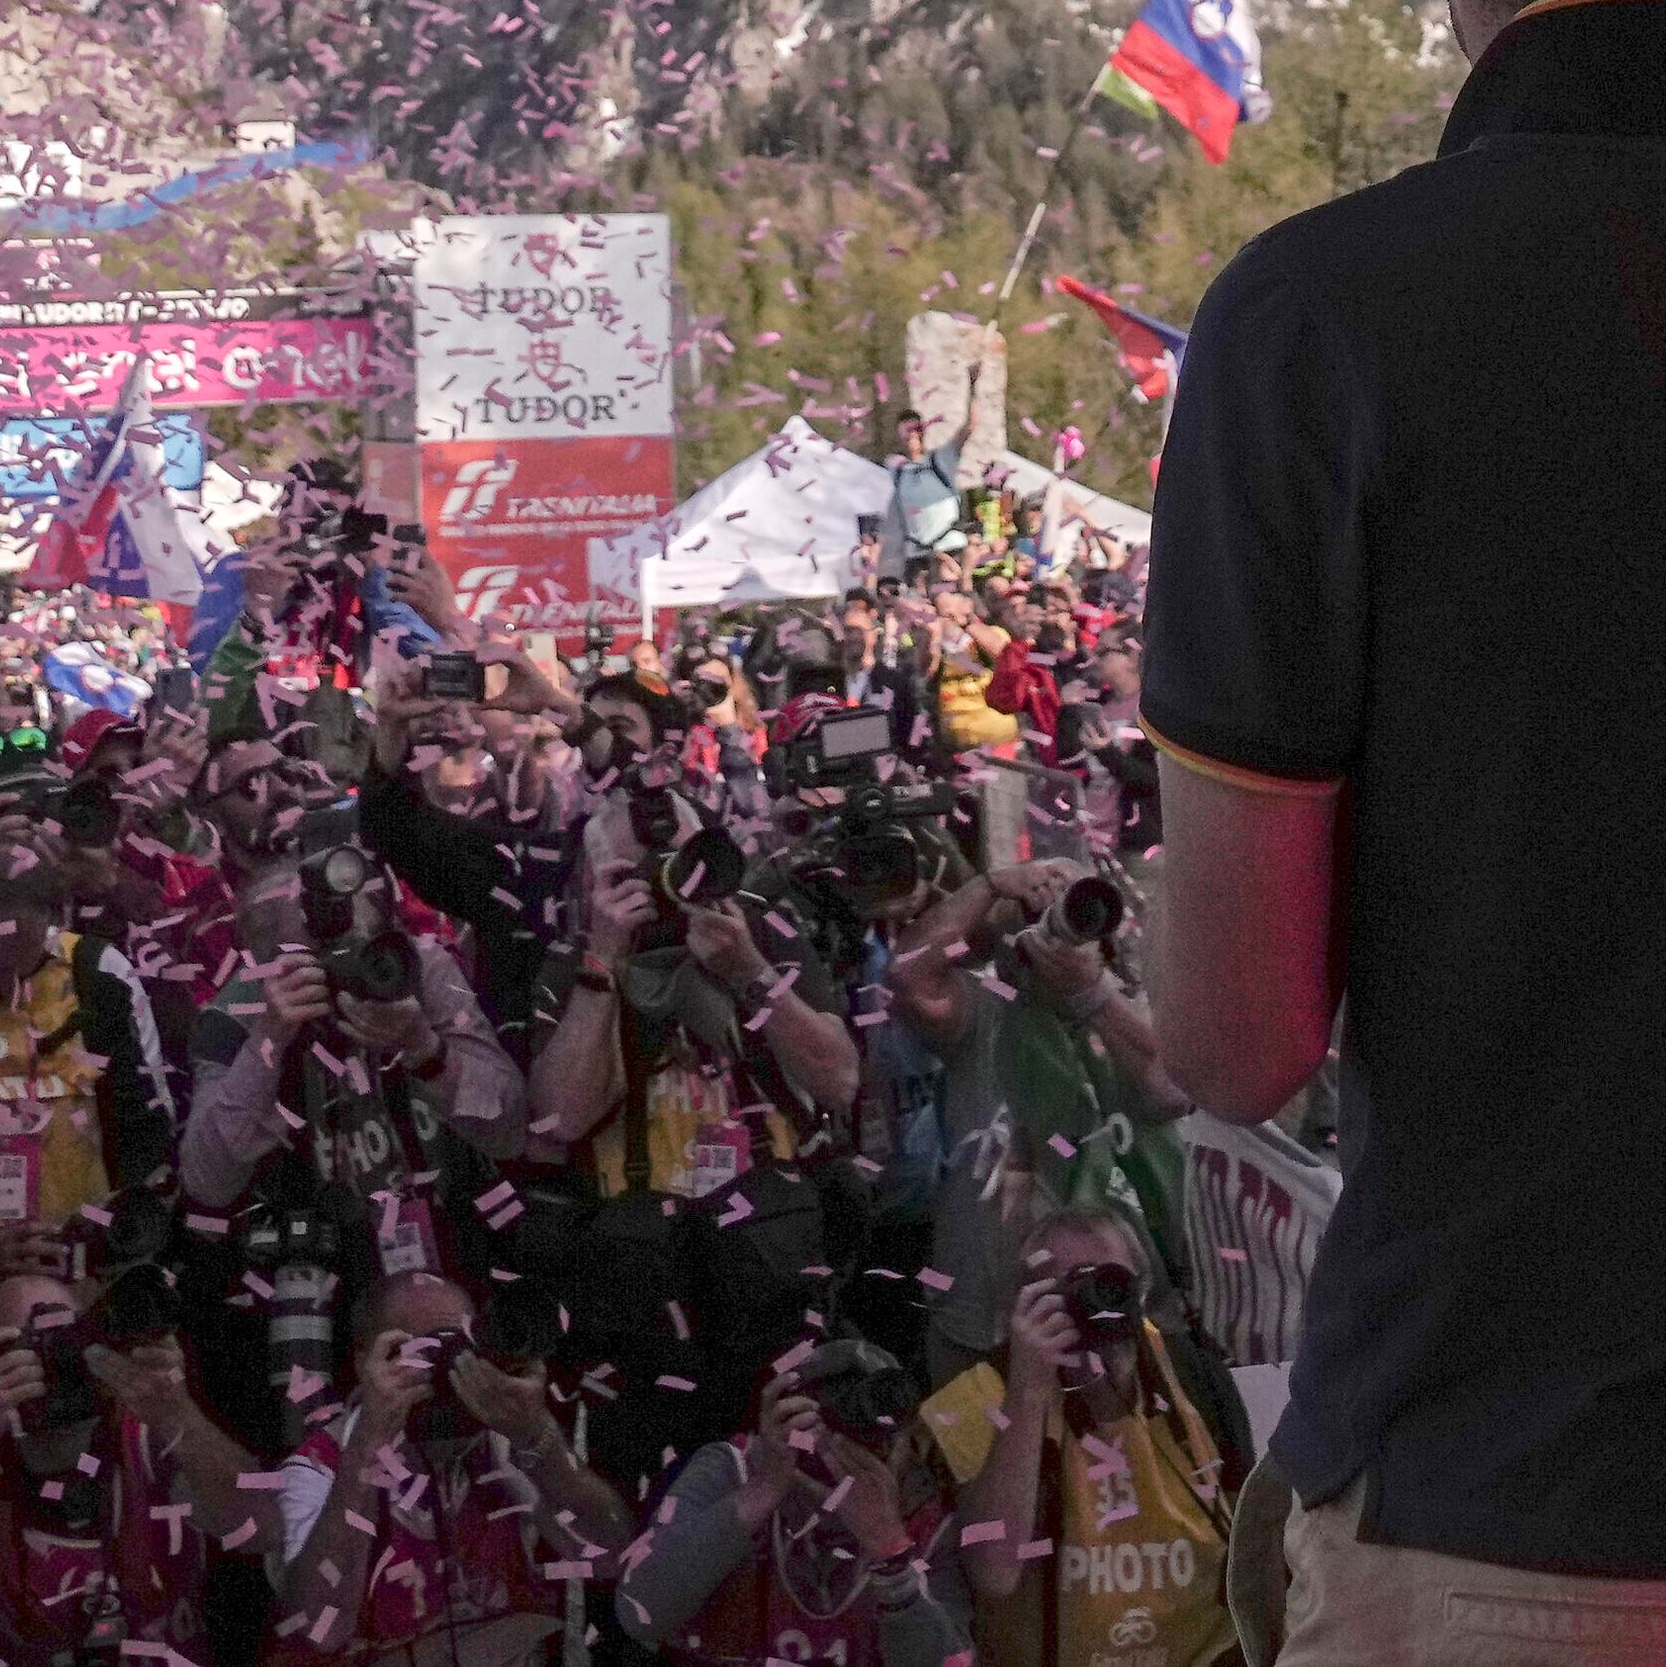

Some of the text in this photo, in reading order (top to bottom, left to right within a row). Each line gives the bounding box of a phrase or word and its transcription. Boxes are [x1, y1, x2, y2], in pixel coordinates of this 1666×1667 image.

[471, 286, 618, 315] TUDOR
[474, 394, 618, 424] TUDOR
[1060, 1538, 1196, 1595] PHOTO
